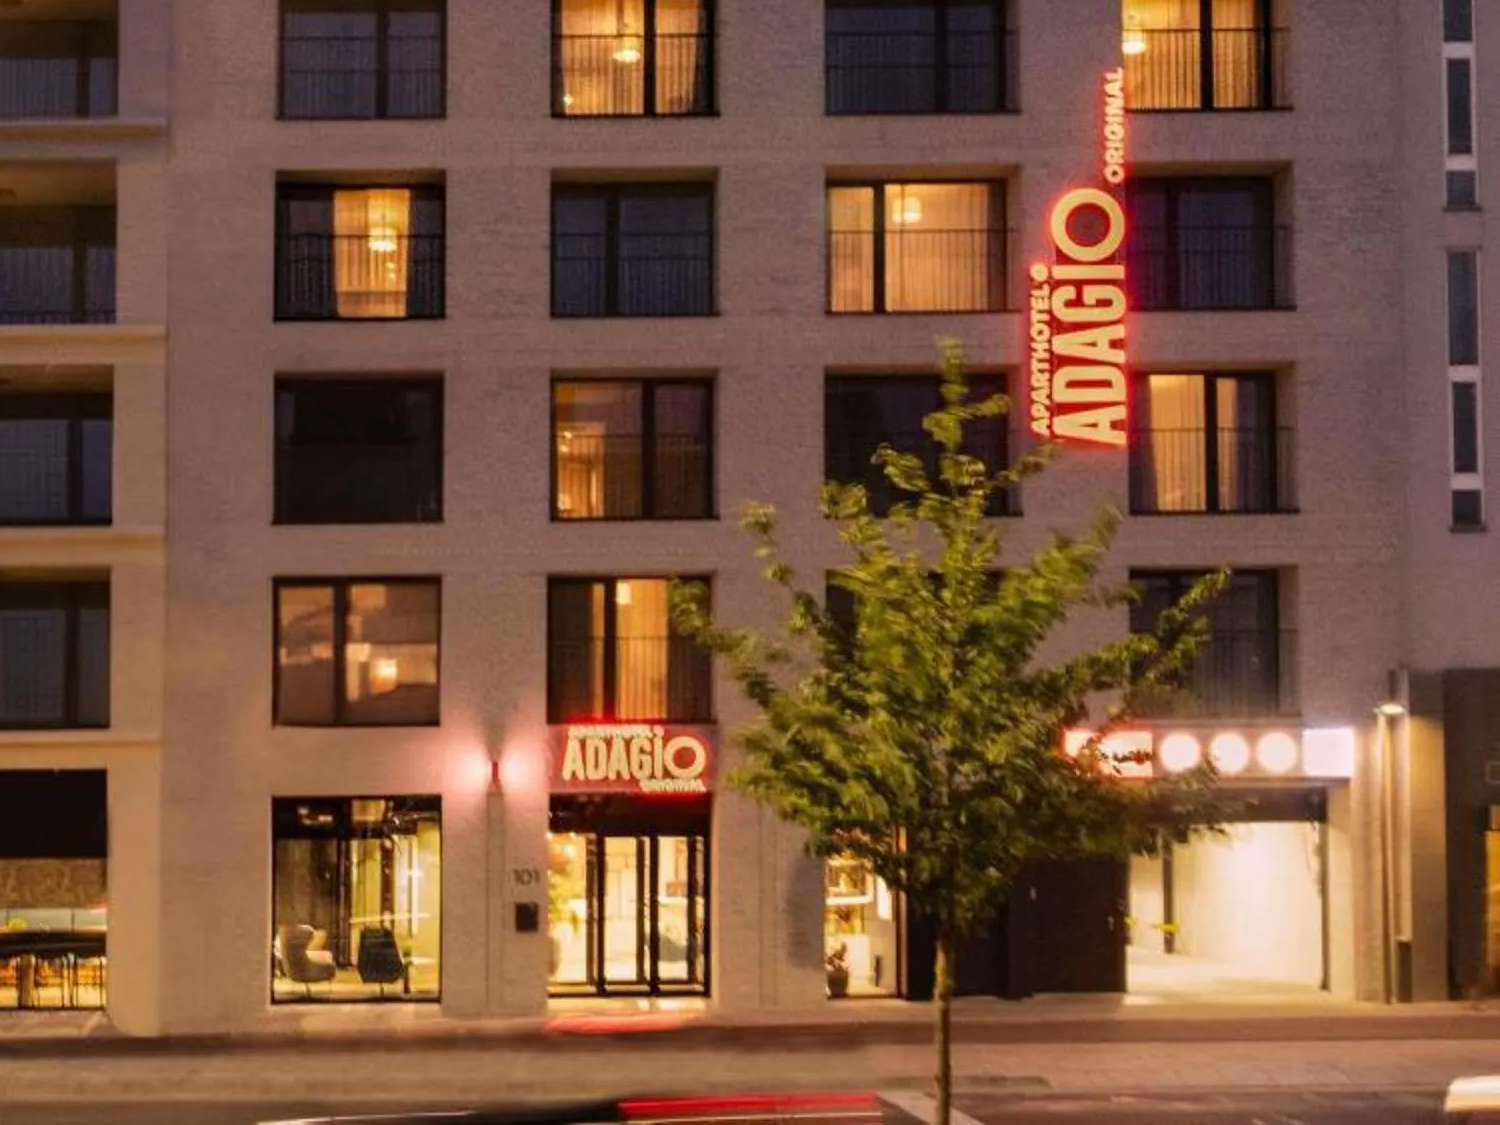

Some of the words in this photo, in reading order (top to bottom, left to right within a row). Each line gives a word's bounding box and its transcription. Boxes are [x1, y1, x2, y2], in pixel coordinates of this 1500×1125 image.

[1104, 67, 1125, 183] ORIGINAL
[1030, 285, 1051, 437] APARTHOTEL
[1050, 187, 1128, 447] ADAGIO
[561, 736, 707, 781] ADAGIO
[513, 867, 540, 885] 101
